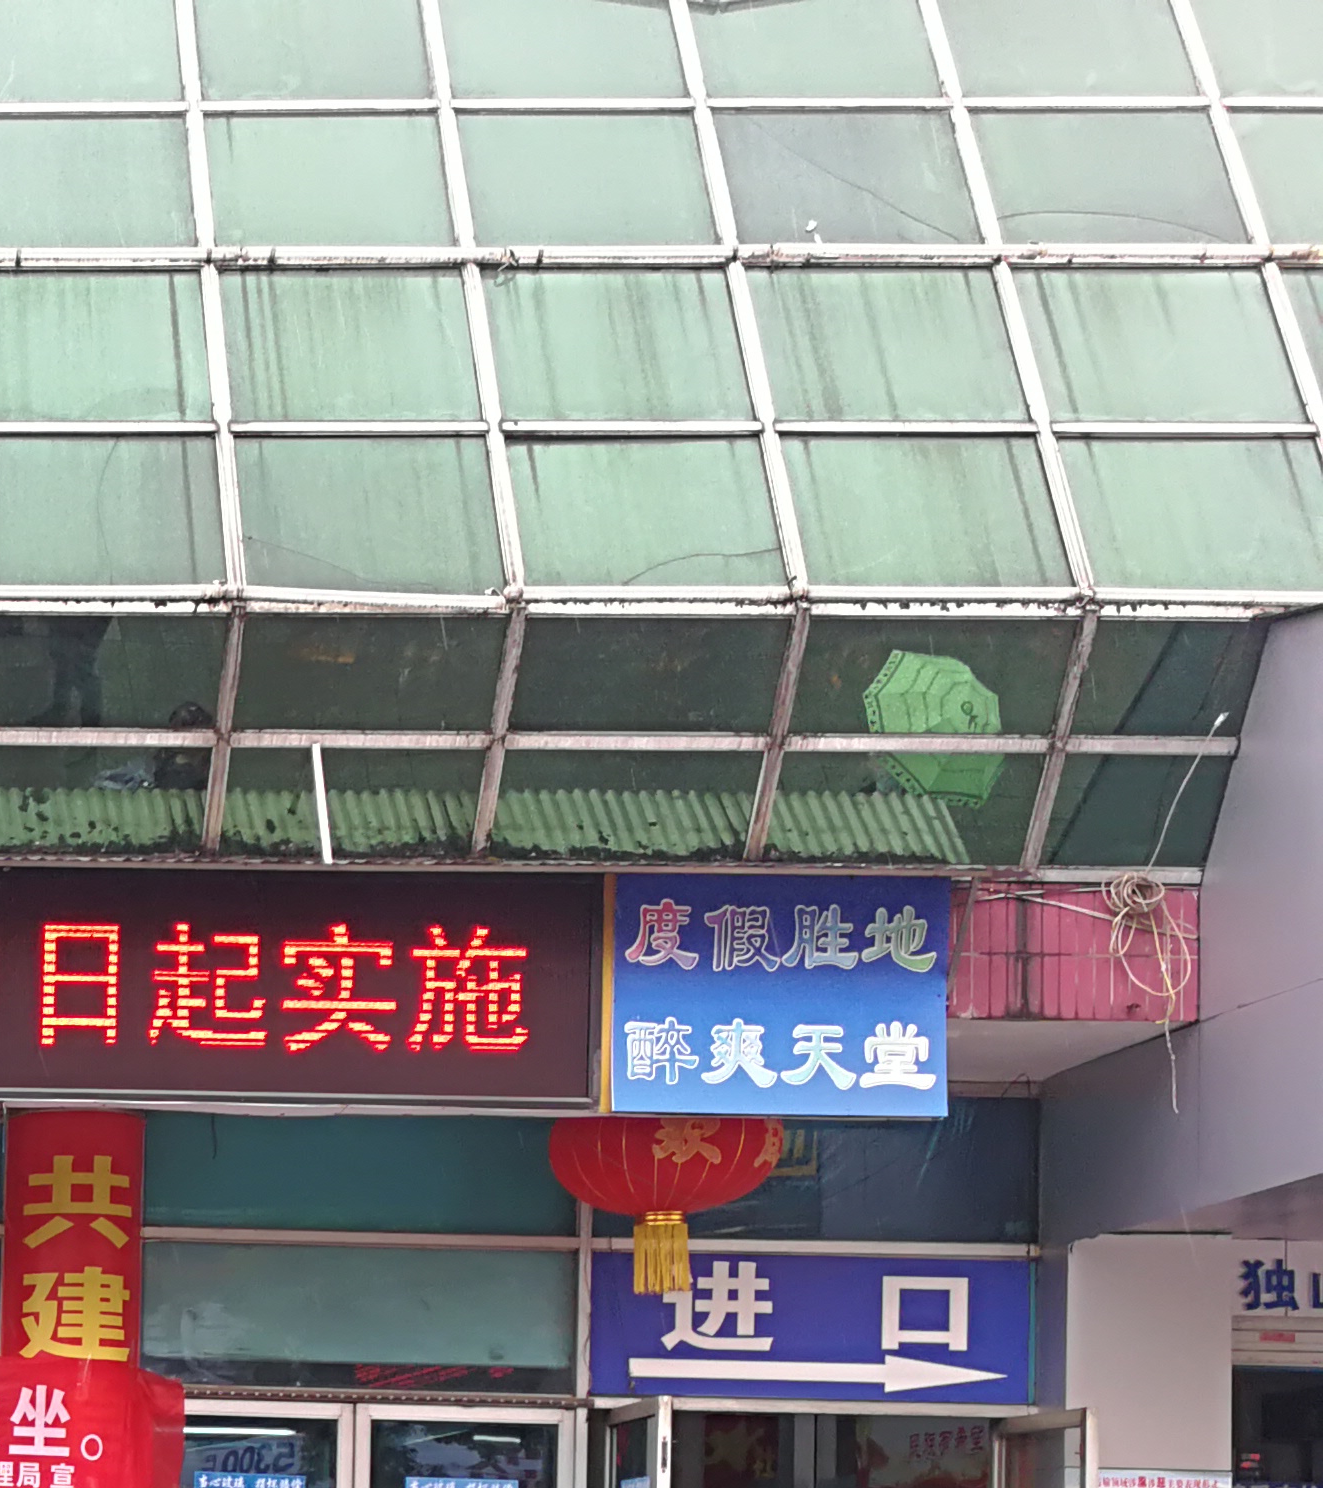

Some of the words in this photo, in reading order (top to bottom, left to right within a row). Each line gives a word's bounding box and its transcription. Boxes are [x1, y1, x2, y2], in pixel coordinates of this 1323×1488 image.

[624, 898, 937, 974] 度假胜地
[624, 1016, 937, 1091] 醉爽天堂
[1238, 1258, 1323, 1311] 独
